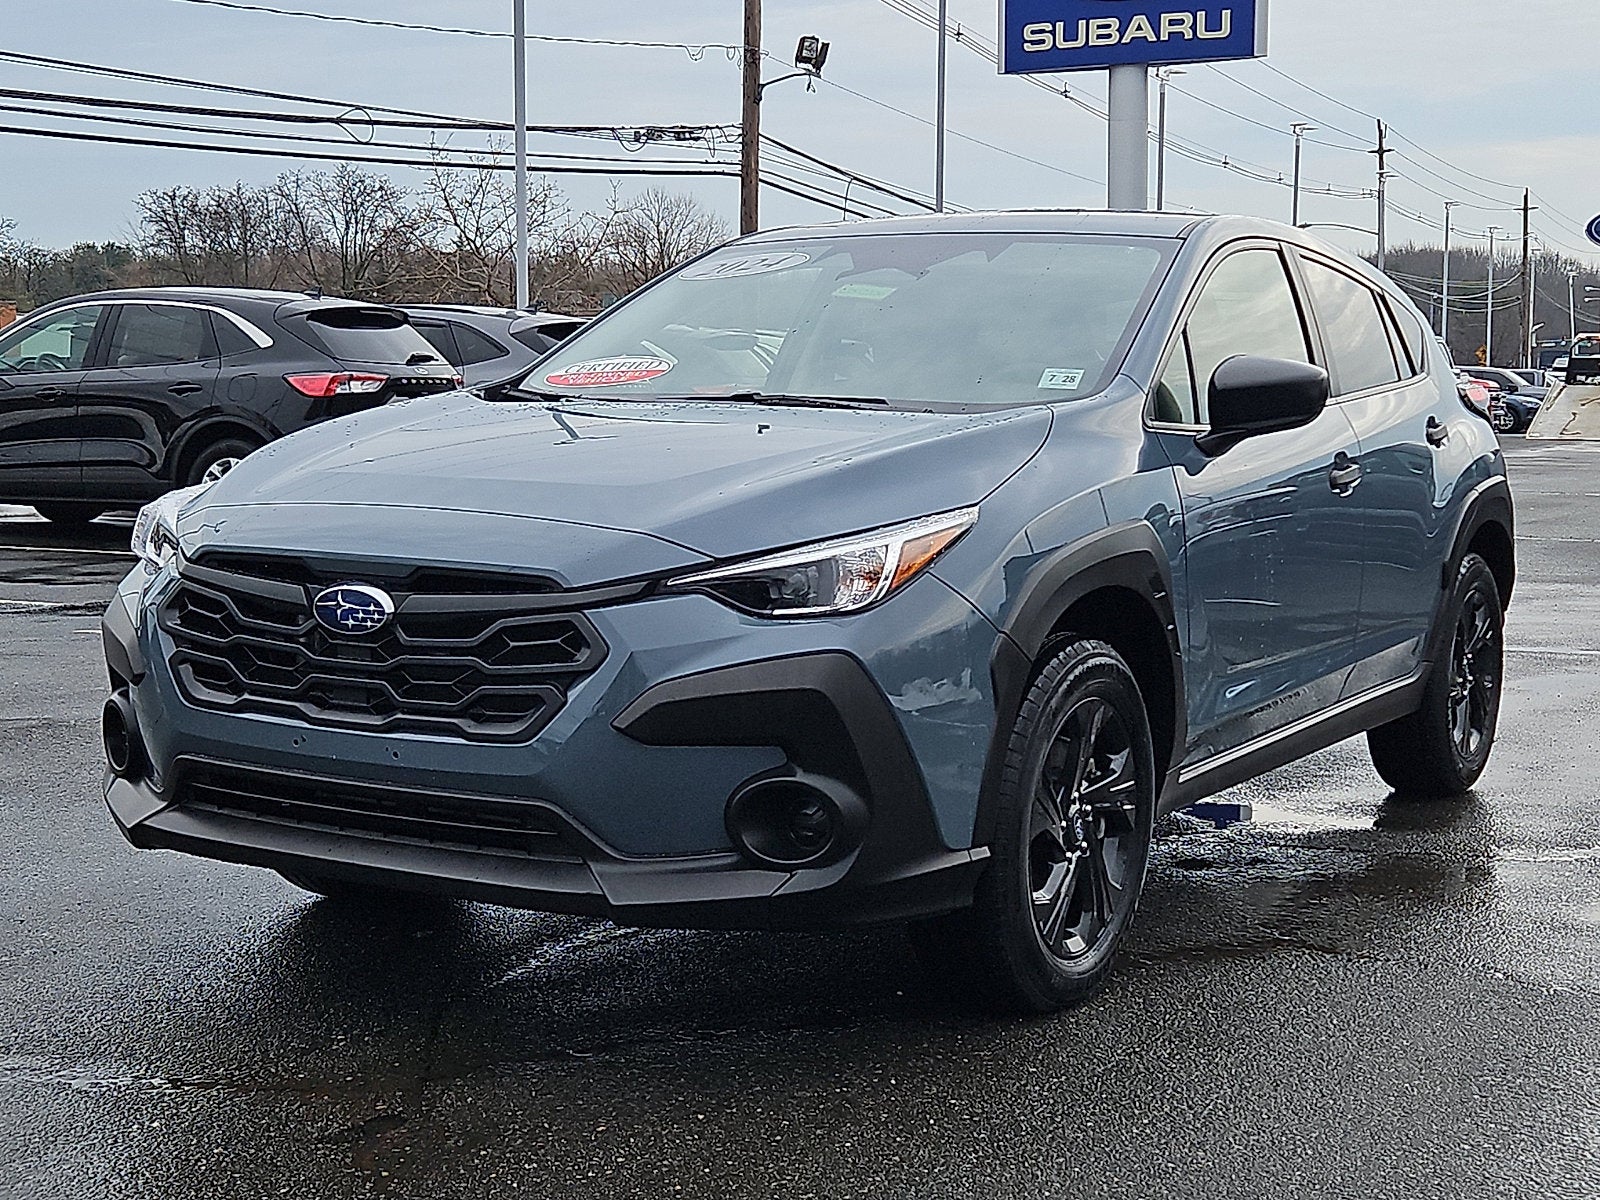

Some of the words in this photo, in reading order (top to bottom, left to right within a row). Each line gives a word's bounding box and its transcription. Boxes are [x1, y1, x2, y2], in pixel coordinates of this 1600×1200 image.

[1023, 9, 1231, 52] SUBARU
[694, 254, 796, 277] 2024
[564, 360, 662, 373] CERTIFIED
[569, 376, 629, 385] VEHICLE
[1048, 374, 1058, 383] 7
